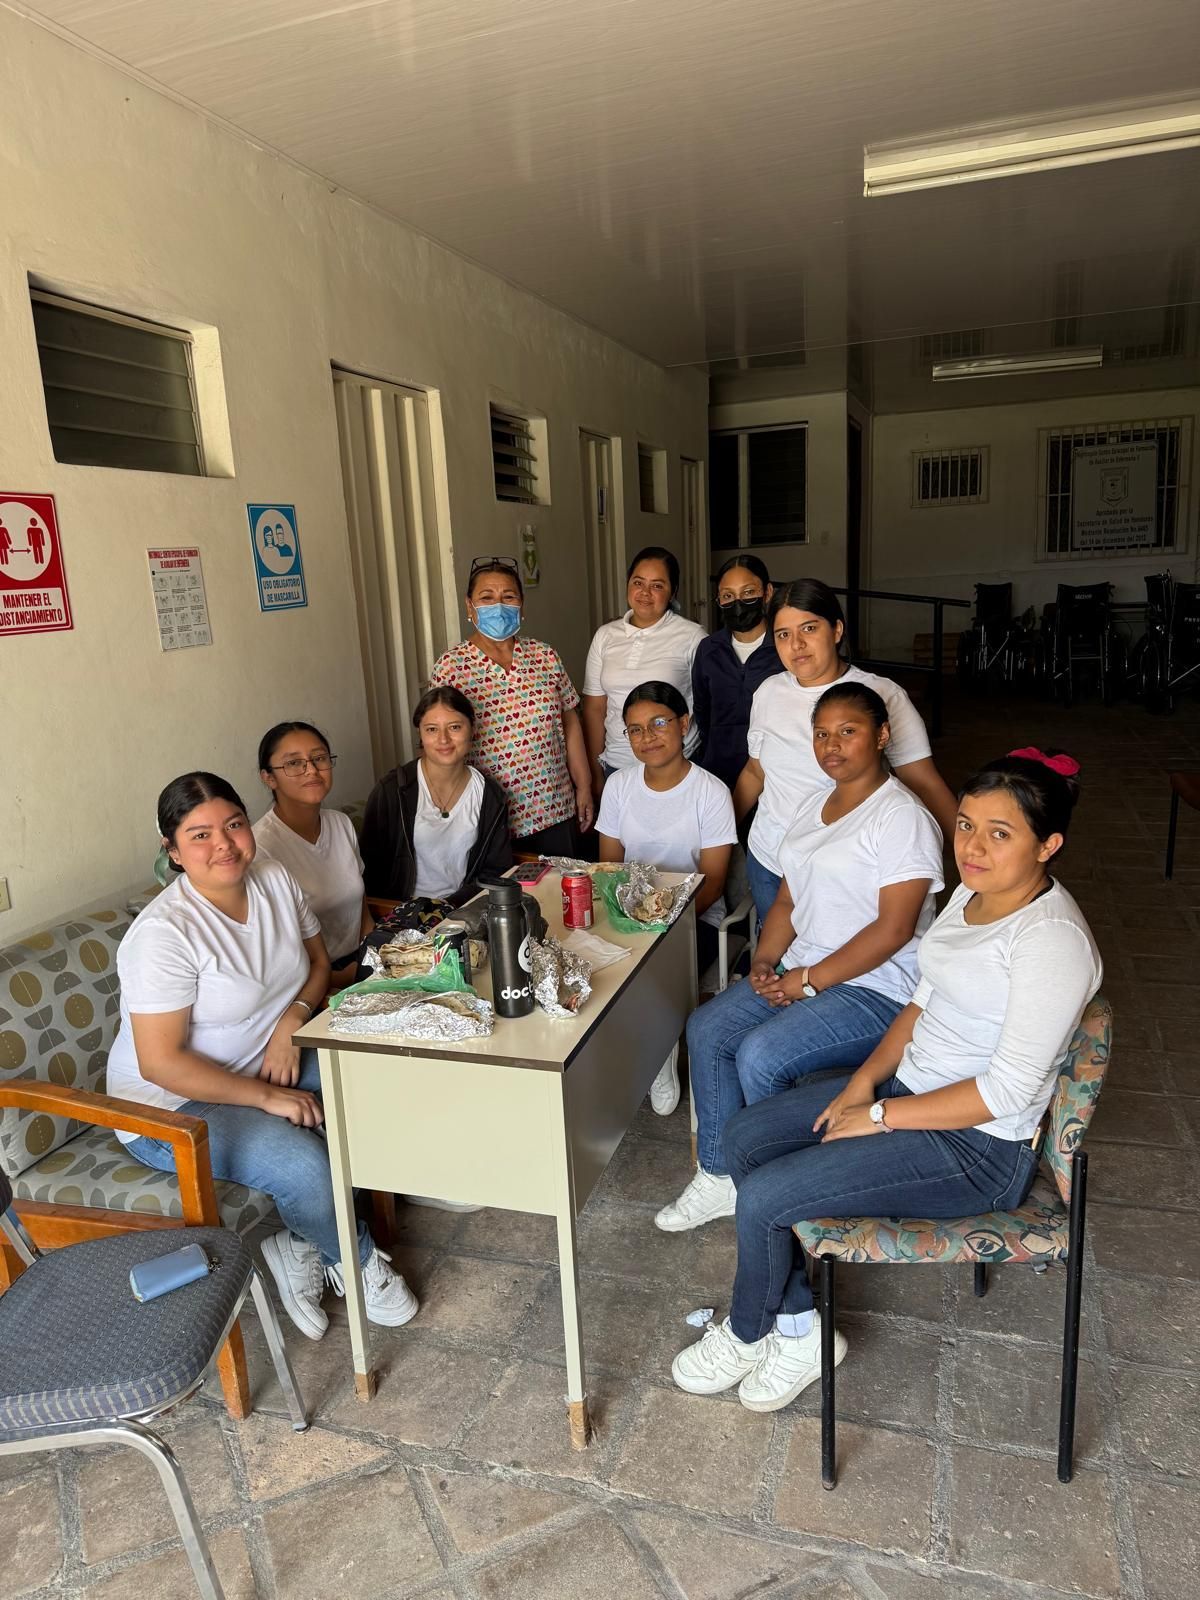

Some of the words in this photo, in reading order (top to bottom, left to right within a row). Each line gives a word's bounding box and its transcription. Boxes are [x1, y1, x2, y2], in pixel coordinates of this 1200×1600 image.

[263, 580, 273, 590] USO
[273, 577, 301, 589] OBLIGATORIO
[3, 593, 42, 608] MANTENER
[43, 592, 52, 606] EL
[267, 593, 274, 603] DE
[274, 591, 301, 602] MASCARILLA
